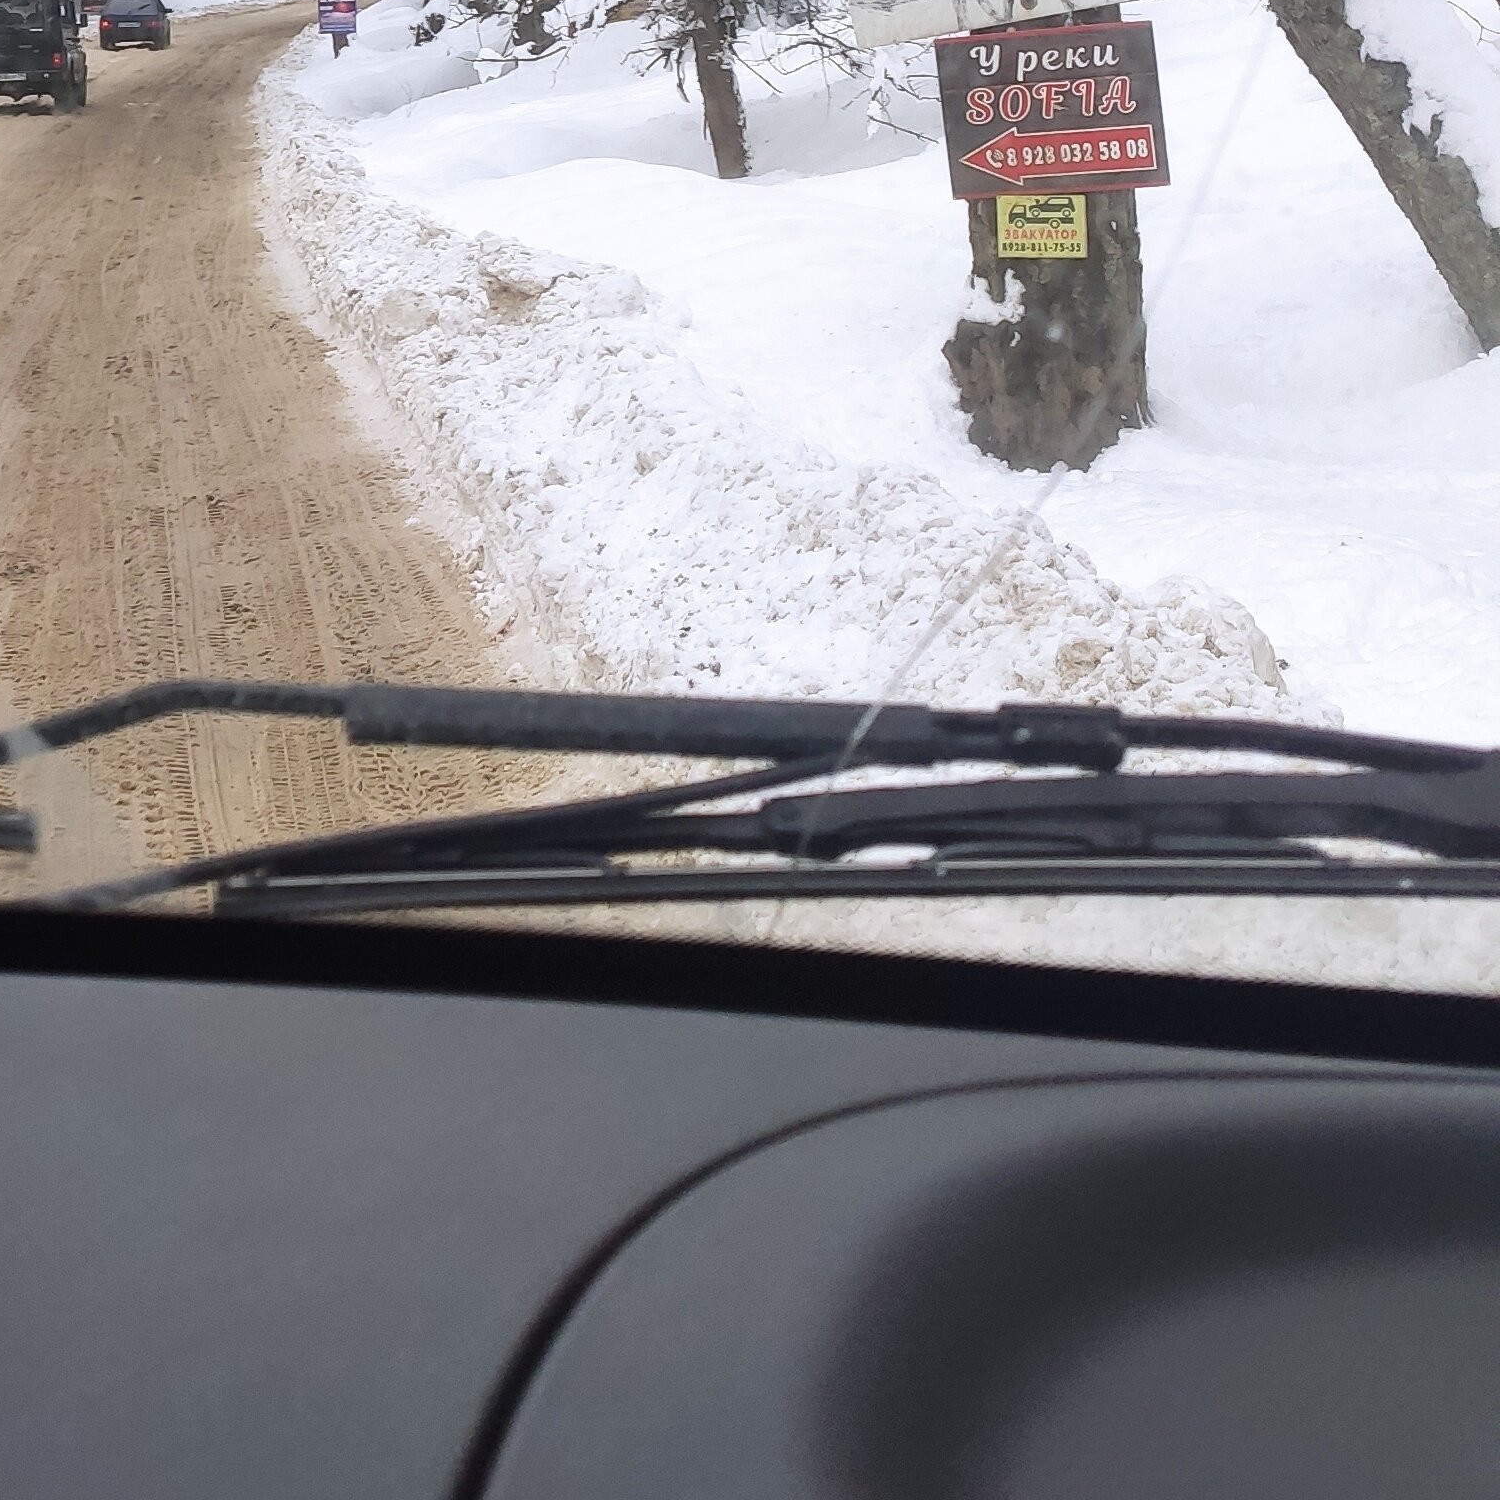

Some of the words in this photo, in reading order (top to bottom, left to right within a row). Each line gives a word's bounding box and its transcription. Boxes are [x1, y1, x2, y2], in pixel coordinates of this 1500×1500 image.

[969, 43, 1002, 76] У
[1016, 43, 1120, 82] реки
[965, 75, 1137, 125] SOFIA
[1005, 147, 1018, 167] 8
[1021, 144, 1056, 166] 928
[1059, 141, 1094, 163] 032
[1098, 139, 1122, 161] 58
[1125, 137, 1149, 160] 08
[1004, 228, 1078, 240] ЭВАКУАТОР
